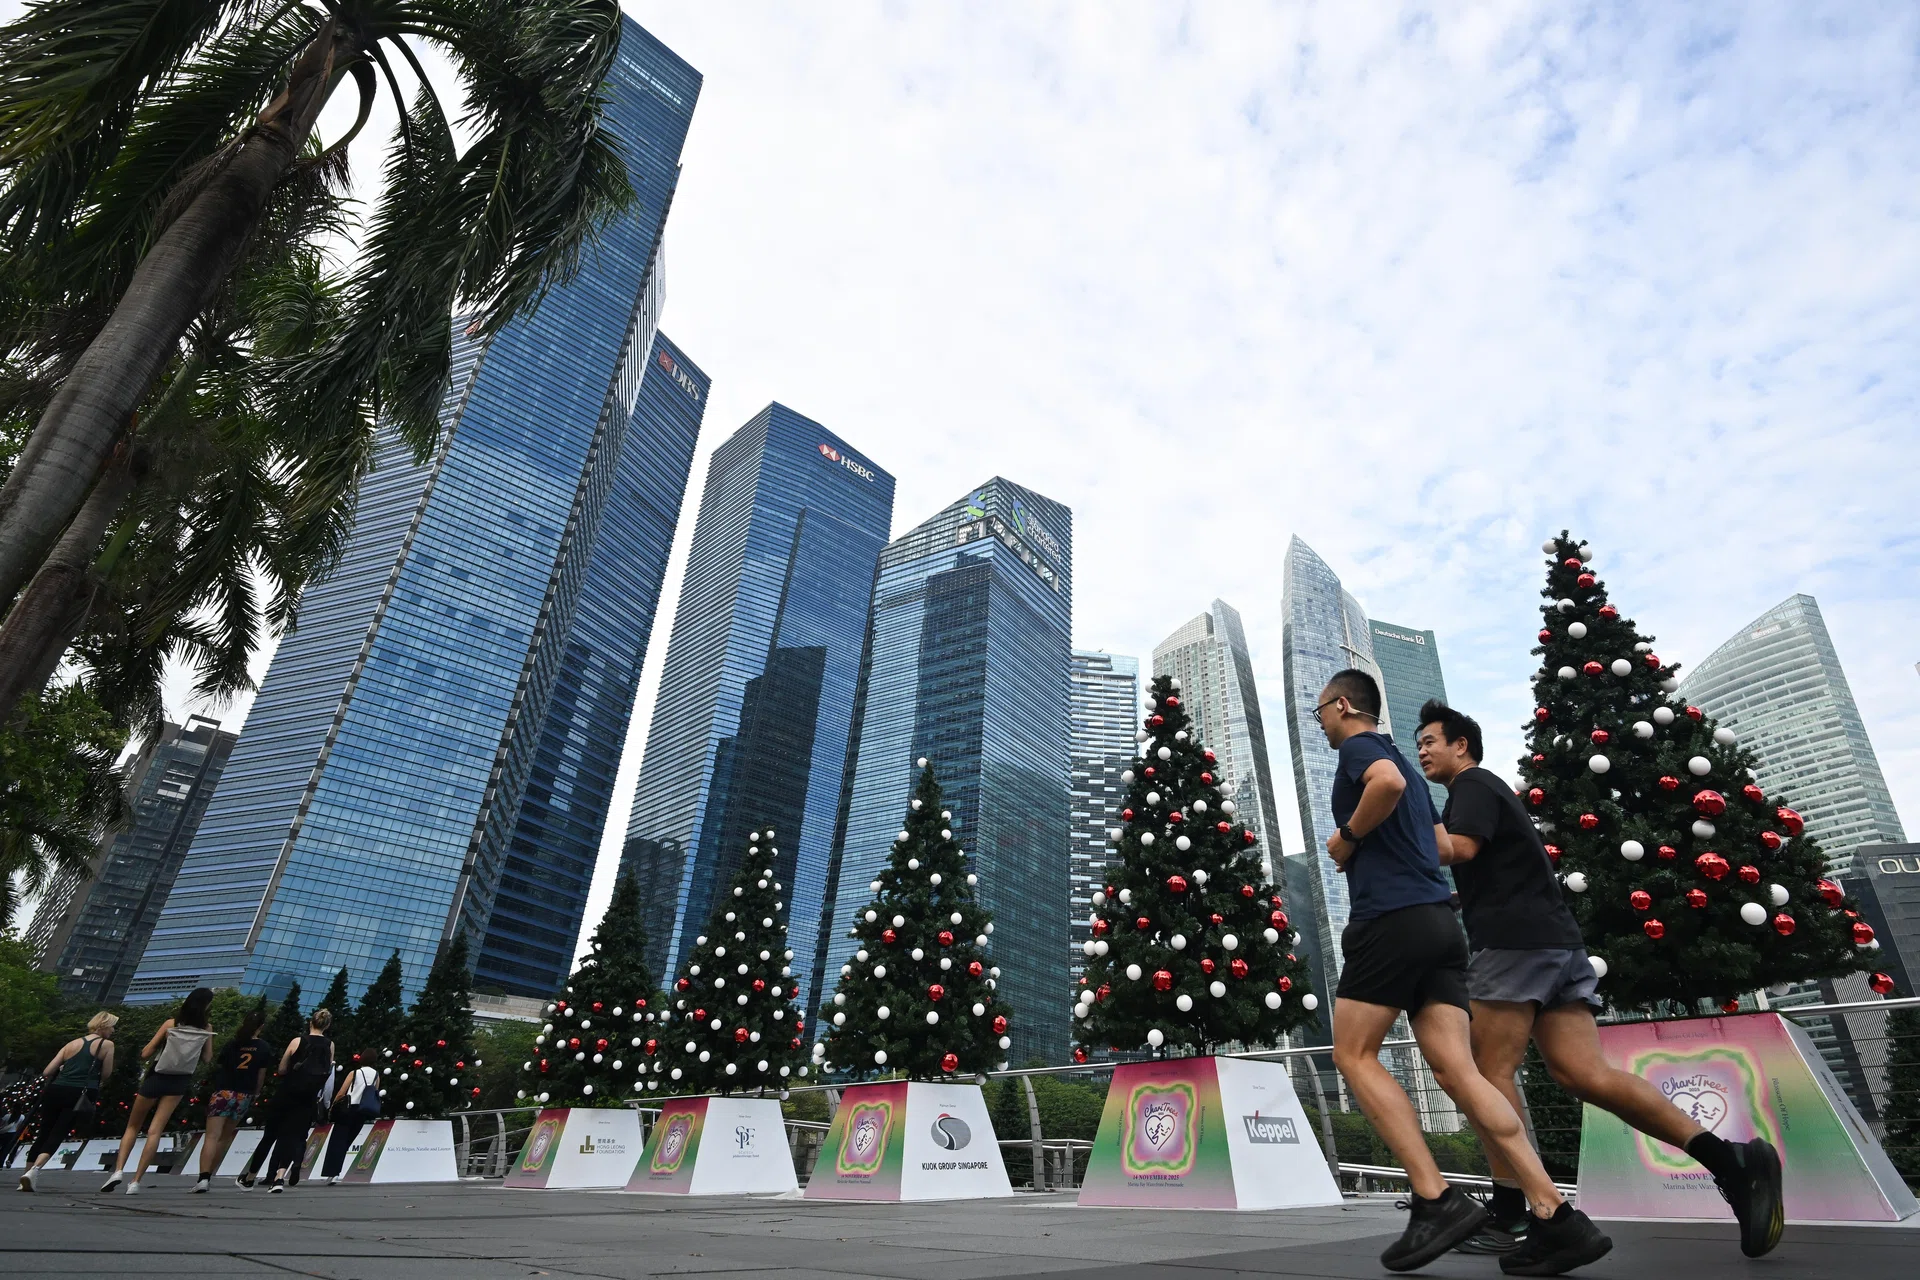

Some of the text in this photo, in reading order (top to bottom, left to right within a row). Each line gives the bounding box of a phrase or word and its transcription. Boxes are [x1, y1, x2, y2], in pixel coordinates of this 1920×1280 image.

[672, 363, 700, 401] DBS
[841, 455, 875, 482] HSBC
[1027, 526, 1061, 563] chartered
[1375, 628, 1415, 643] Deutsche Bank
[236, 1053, 252, 1069] 2
[1662, 1074, 1728, 1095] ChariTrees
[1144, 1102, 1179, 1118] ChariTrees
[1779, 1103, 1788, 1112] Of
[1246, 1118, 1296, 1142] Keppel
[1781, 1113, 1791, 1131] Hope
[922, 1161, 988, 1170] KUOK GROUP SINGAPORE
[1686, 1183, 1698, 1191] Bay
